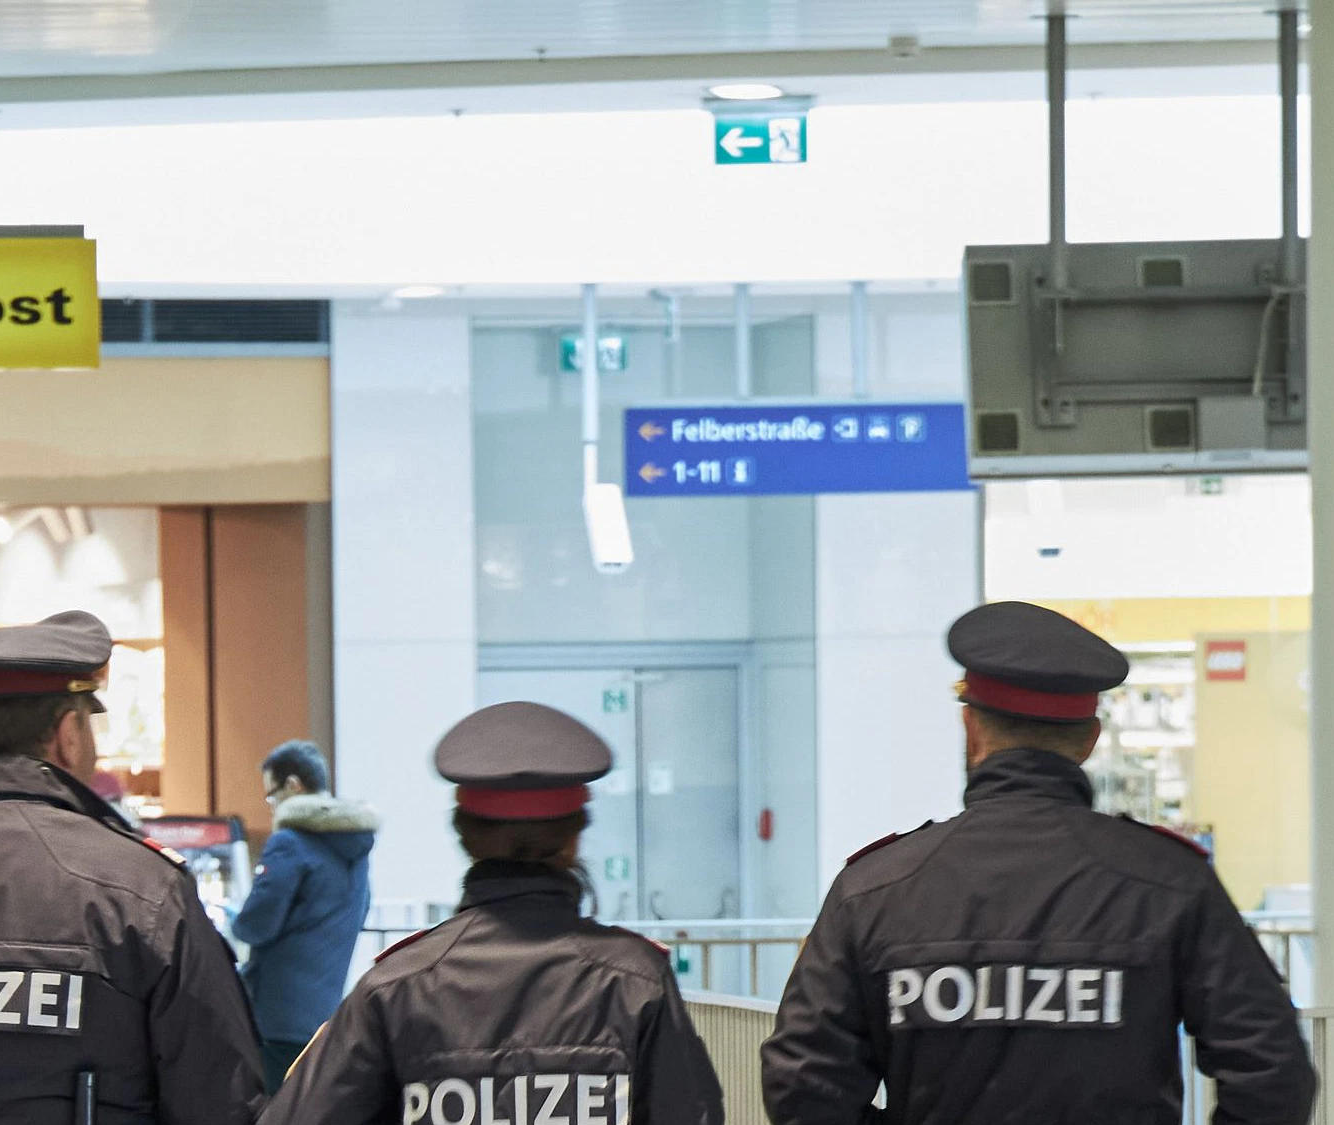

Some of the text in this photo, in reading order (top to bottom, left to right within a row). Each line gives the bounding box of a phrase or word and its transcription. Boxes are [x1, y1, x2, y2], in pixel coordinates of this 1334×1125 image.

[672, 416, 825, 442] Felberstraße
[673, 460, 721, 483] 1-11
[888, 964, 1123, 1024] POLIZEI
